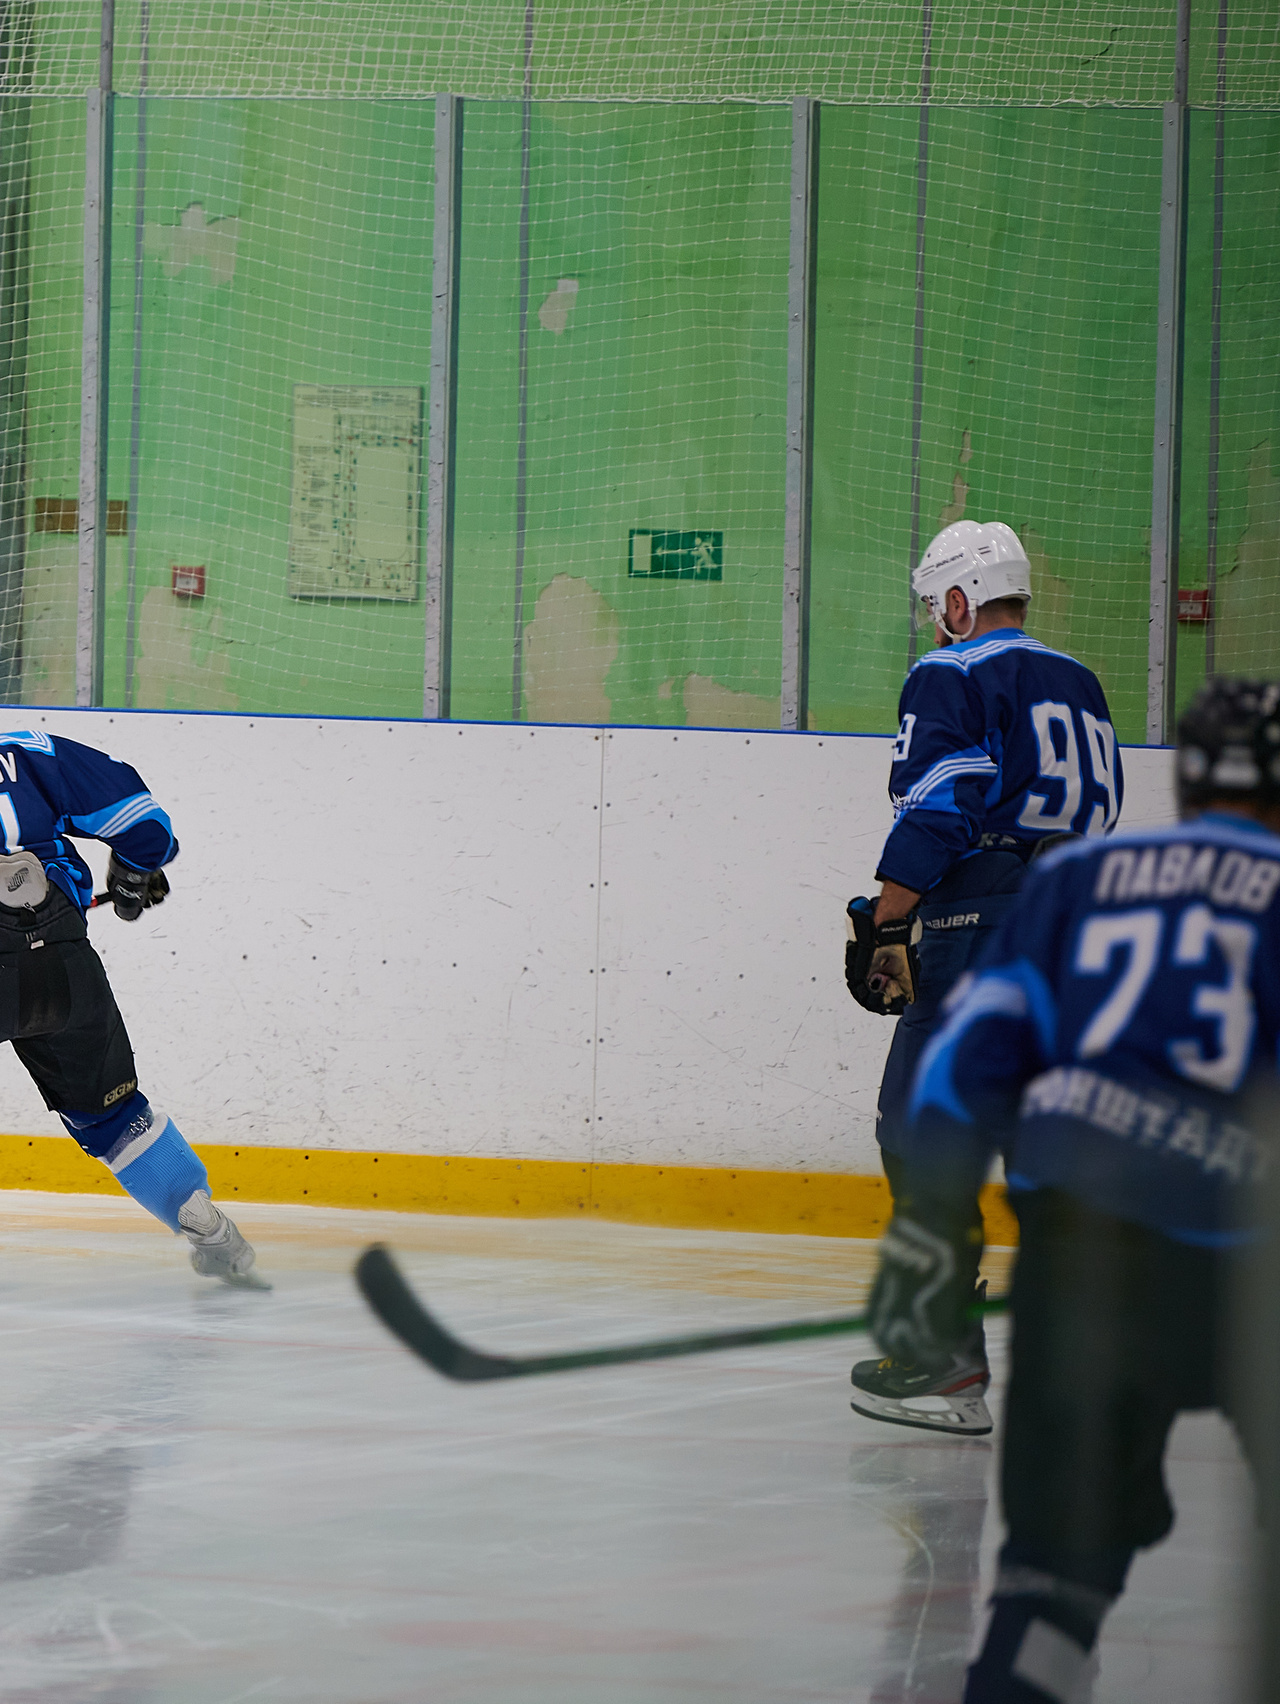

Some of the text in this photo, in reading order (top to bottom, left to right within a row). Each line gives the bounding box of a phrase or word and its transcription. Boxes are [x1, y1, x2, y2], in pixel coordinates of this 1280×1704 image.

[1017, 700, 1119, 837] 99
[1094, 844, 1280, 913] ПАВЛОВ
[1076, 906, 1257, 1092] 73
